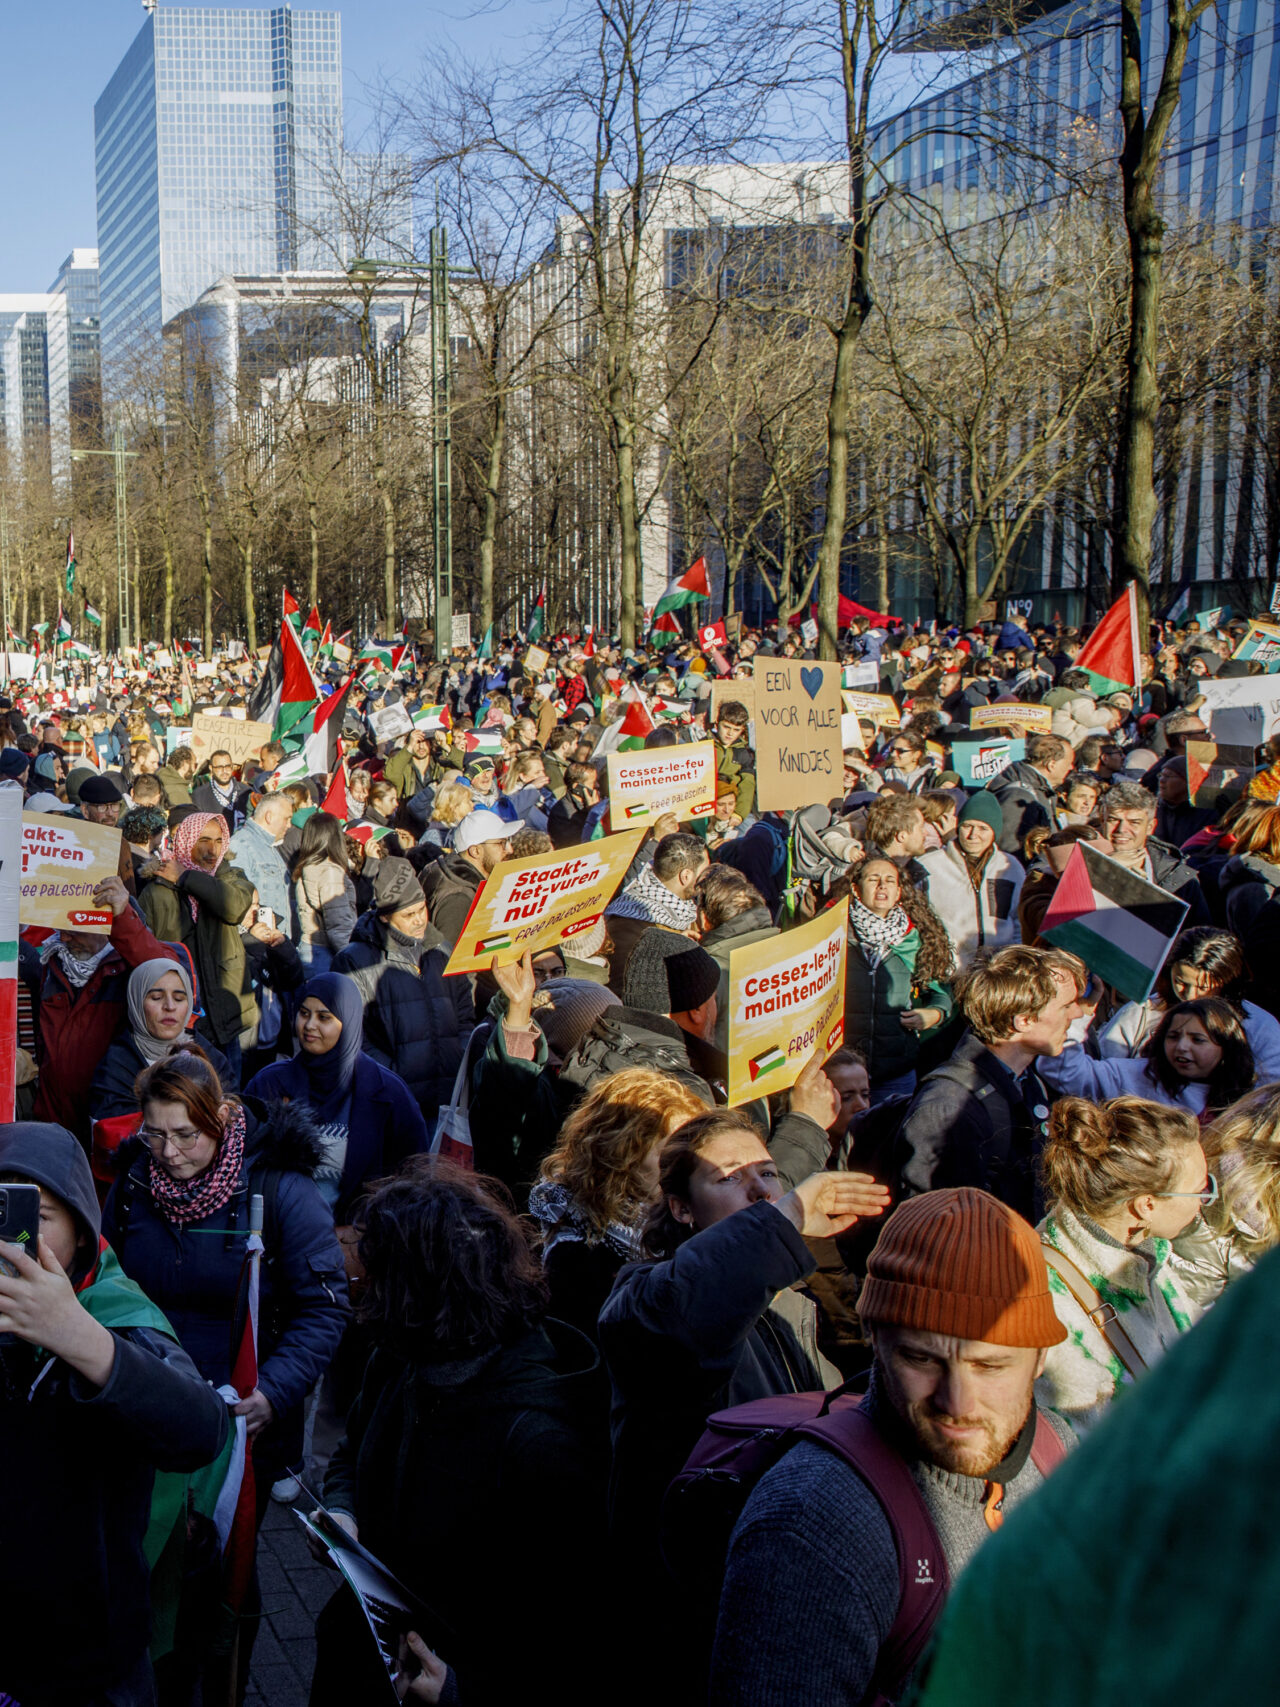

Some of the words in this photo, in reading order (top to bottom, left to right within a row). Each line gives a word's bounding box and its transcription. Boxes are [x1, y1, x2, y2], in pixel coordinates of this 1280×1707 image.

[766, 667, 791, 692] EEN
[761, 705, 799, 727] VOOR
[808, 708, 838, 731] ALLE
[208, 735, 251, 756] NOW
[620, 759, 704, 779] Cessez-le-feu
[778, 746, 832, 775] KINDJES
[382, 865, 411, 900] Sport
[508, 869, 600, 903] het-vuren
[515, 859, 587, 887] Staakt-
[88, 915, 107, 923] pvda
[504, 895, 548, 923] nu!
[745, 937, 840, 997] Cessez-le-feu
